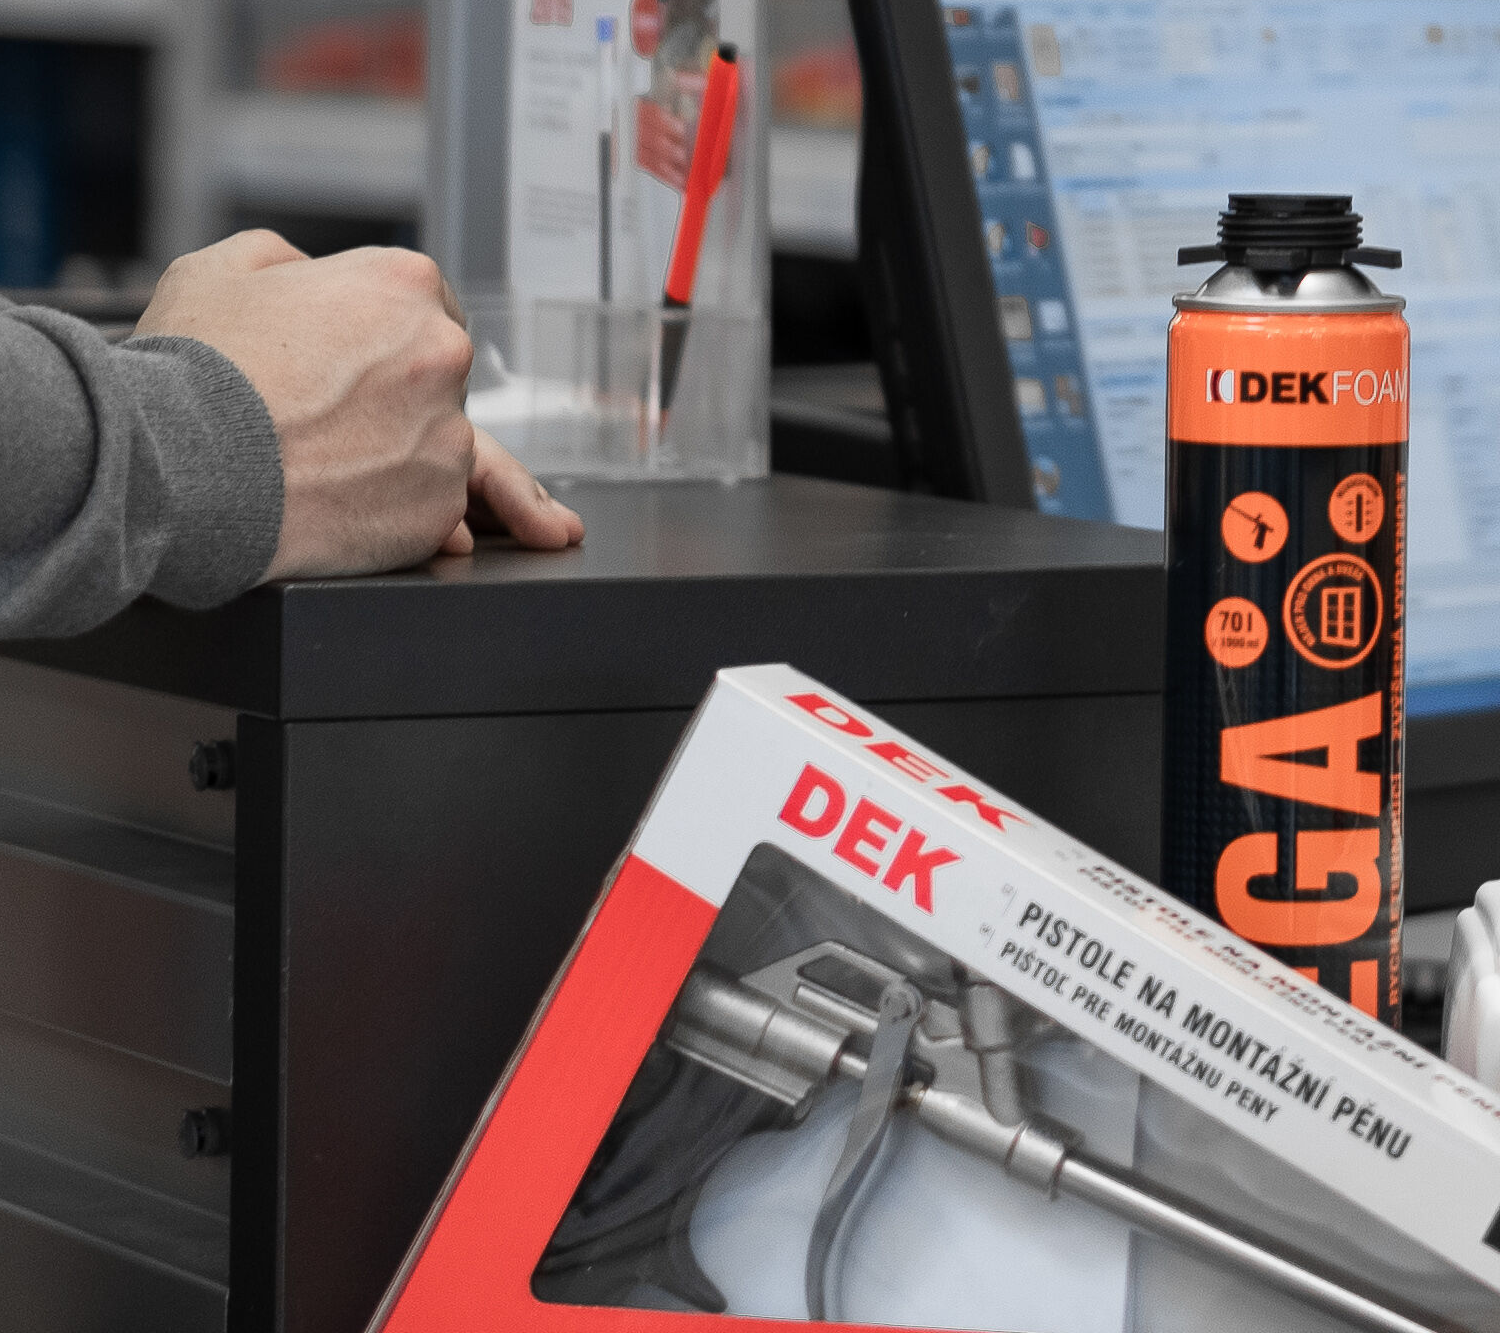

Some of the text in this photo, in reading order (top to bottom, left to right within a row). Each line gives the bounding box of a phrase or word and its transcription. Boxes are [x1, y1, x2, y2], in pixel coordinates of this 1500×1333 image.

[1219, 611, 1243, 631] 70
[783, 692, 1035, 832] DEK
[778, 762, 962, 916] DEK
[1018, 900, 1412, 1162] PISTOLE NA MONTÁŽNÍ PĚNU
[1073, 983, 1111, 1022] PRE
[1114, 1004, 1220, 1091] MONTÁŽNU
[1223, 1078, 1280, 1126] PENY
